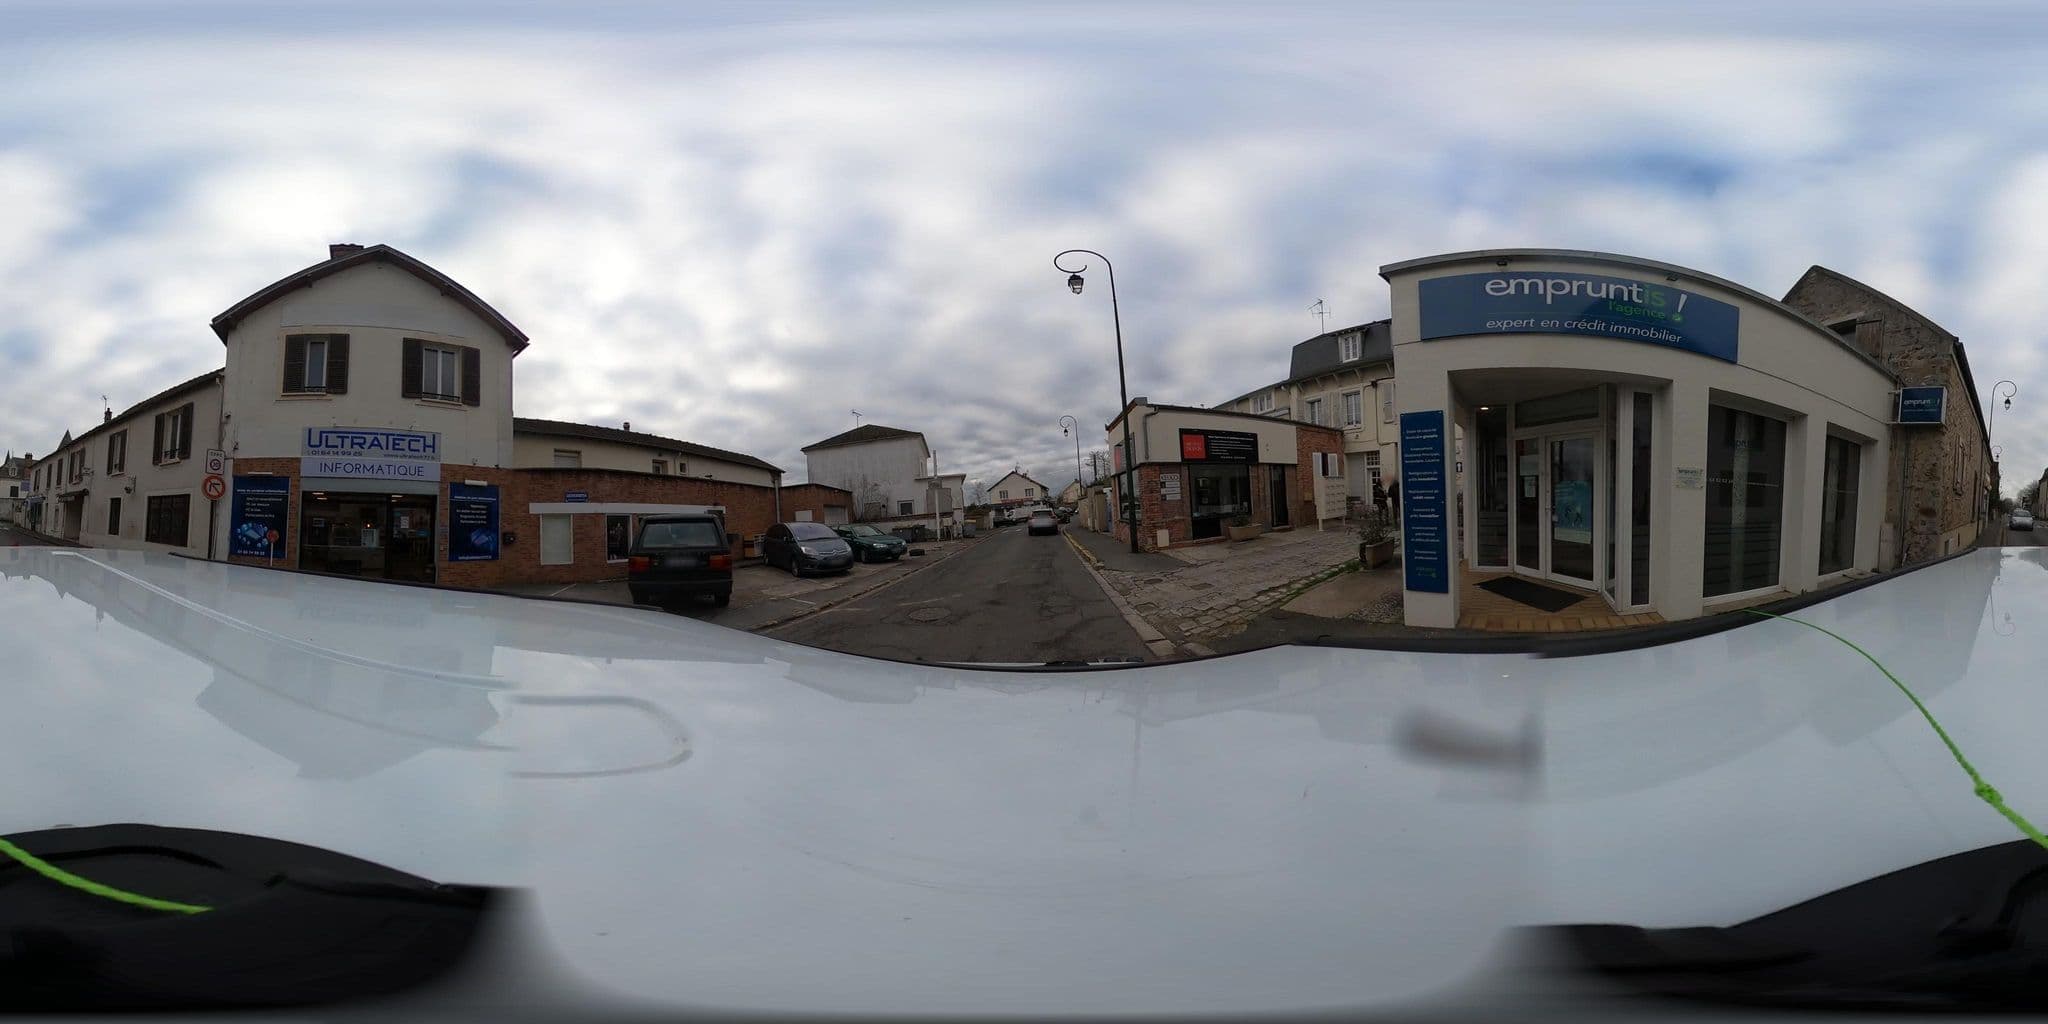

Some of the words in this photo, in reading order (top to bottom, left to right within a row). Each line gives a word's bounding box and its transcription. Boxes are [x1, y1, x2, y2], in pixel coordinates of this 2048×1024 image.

[1608, 301, 1666, 320] l'agence
[1486, 318, 1535, 331] expert
[1540, 319, 1560, 329] en
[1564, 319, 1606, 332] crédit
[1609, 322, 1682, 343] immobilier
[307, 428, 436, 453] ULTRATECH
[319, 462, 425, 477] INFORMATIQUE
